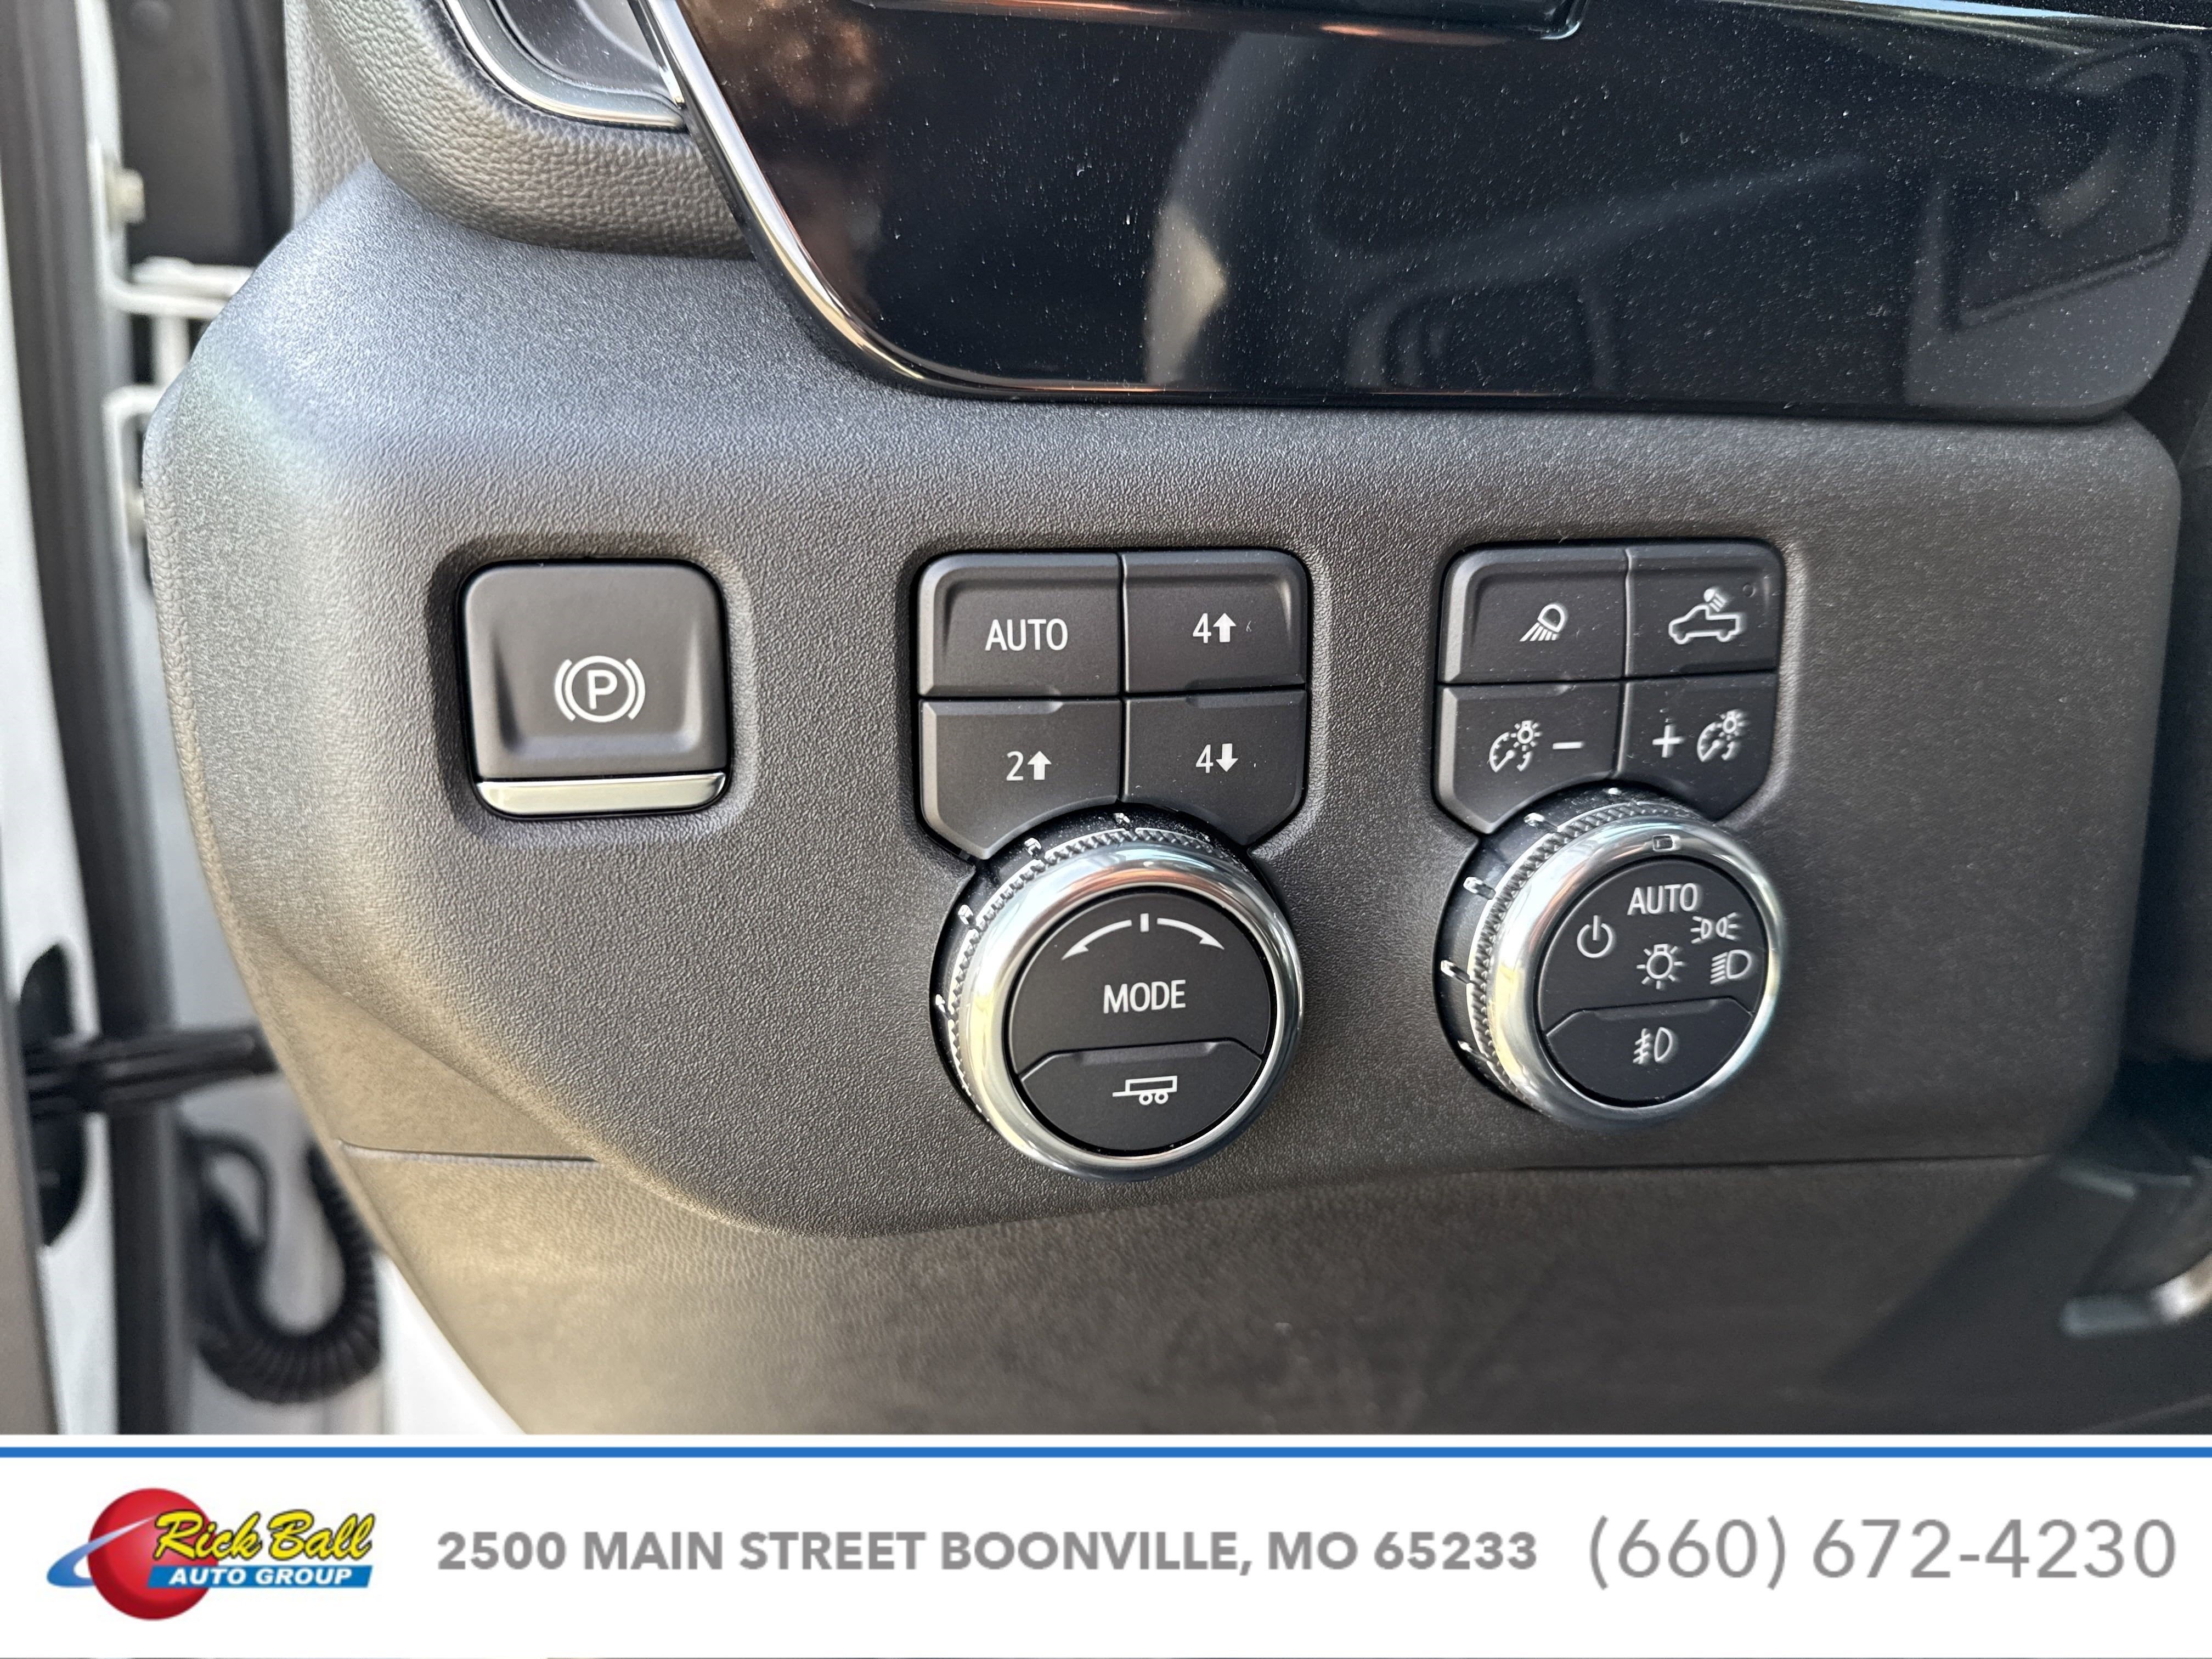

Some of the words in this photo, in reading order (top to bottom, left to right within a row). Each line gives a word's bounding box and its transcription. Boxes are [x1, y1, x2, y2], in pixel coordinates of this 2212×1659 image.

[985, 618, 1068, 651] AUTO
[1192, 613, 1212, 644] 4
[586, 669, 618, 709] P
[1006, 751, 1024, 781] 2
[1195, 744, 1214, 774] 4
[1627, 882, 1700, 916] AUTO
[1103, 979, 1186, 1014] MODE
